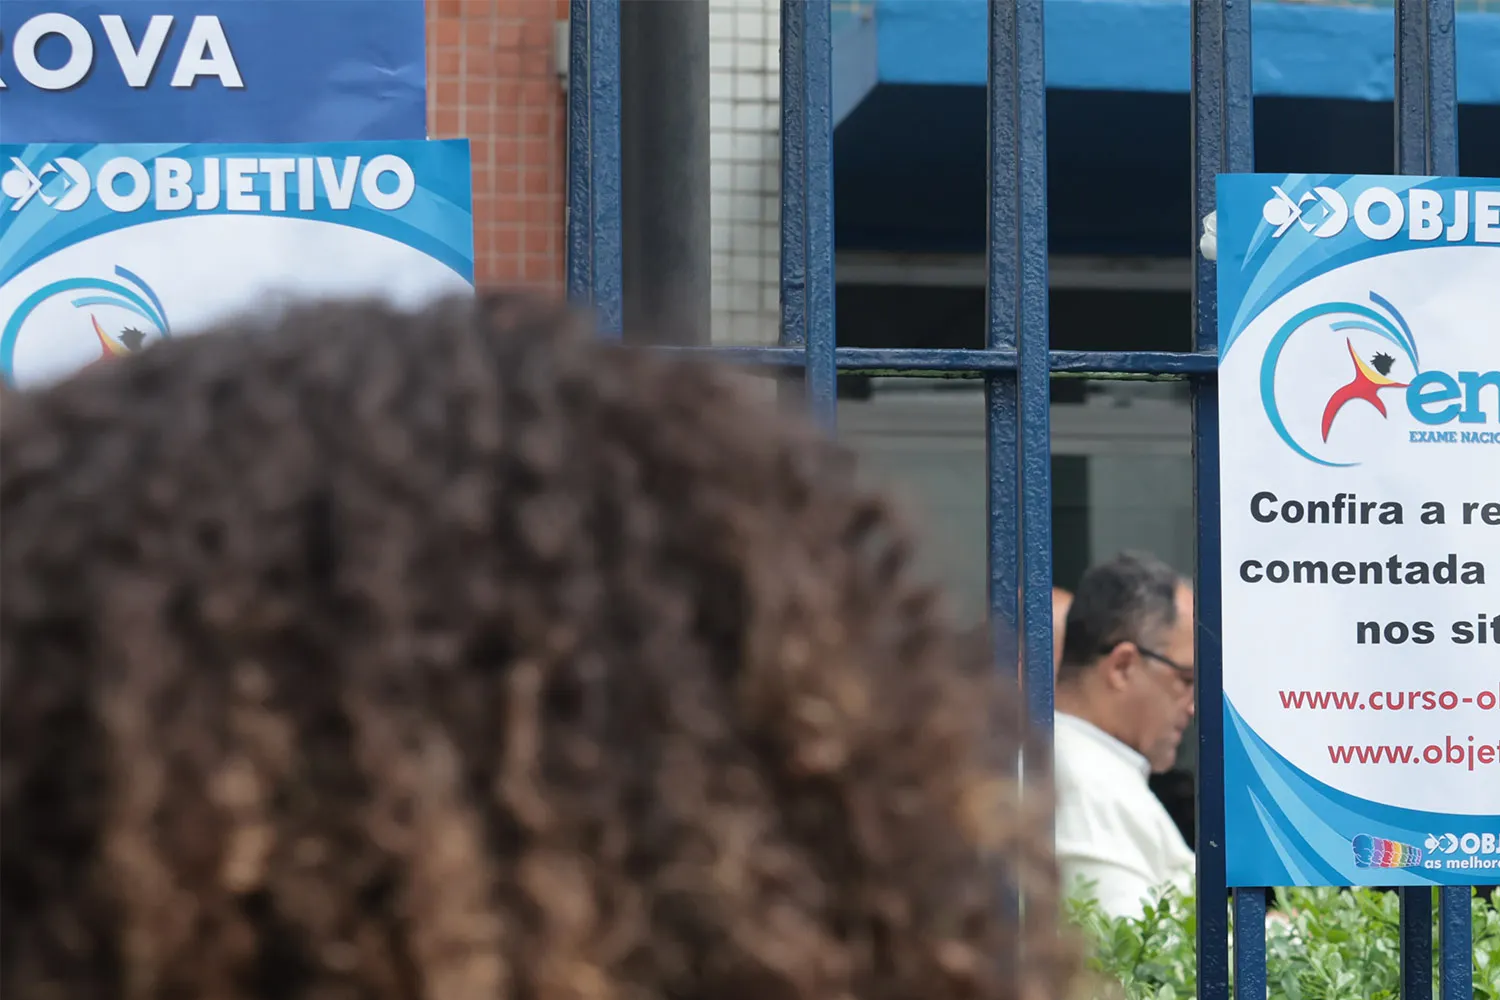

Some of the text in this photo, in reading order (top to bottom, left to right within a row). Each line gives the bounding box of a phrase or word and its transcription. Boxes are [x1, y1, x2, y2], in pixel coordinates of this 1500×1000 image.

[0, 12, 245, 91] OVA
[97, 155, 416, 213] OBJETIVO
[1409, 431, 1457, 443] EXAME
[1250, 491, 1403, 525] Confira
[1421, 500, 1445, 526] a
[1239, 554, 1485, 585] comentada
[1357, 618, 1435, 645] nos
[1424, 859, 1442, 869] as
